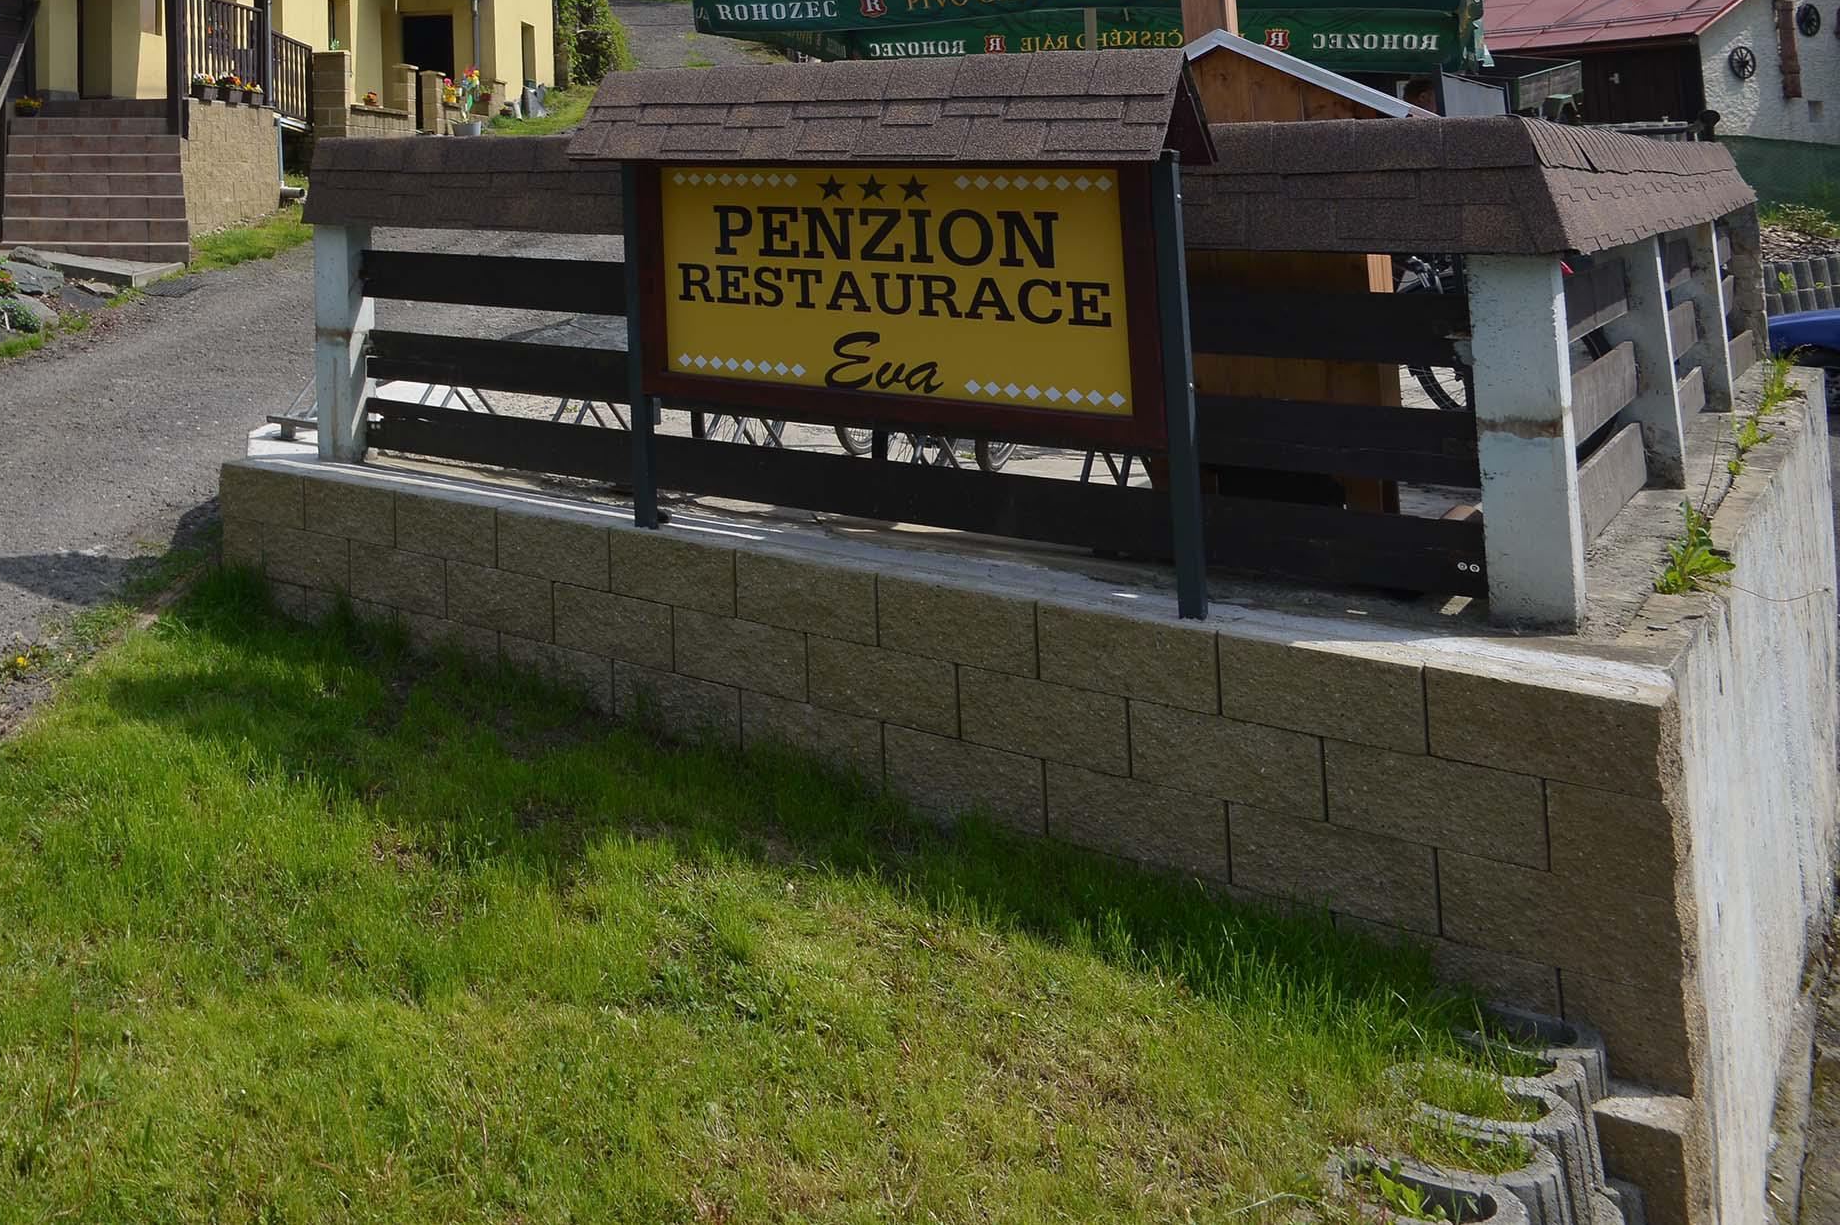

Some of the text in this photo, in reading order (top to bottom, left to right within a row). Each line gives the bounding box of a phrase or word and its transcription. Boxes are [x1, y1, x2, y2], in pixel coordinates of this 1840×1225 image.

[715, 0, 838, 21] ROHOZEC
[712, 204, 1060, 269] PENZION
[678, 262, 1113, 328] RESTAURACE
[824, 331, 945, 394] Eva
